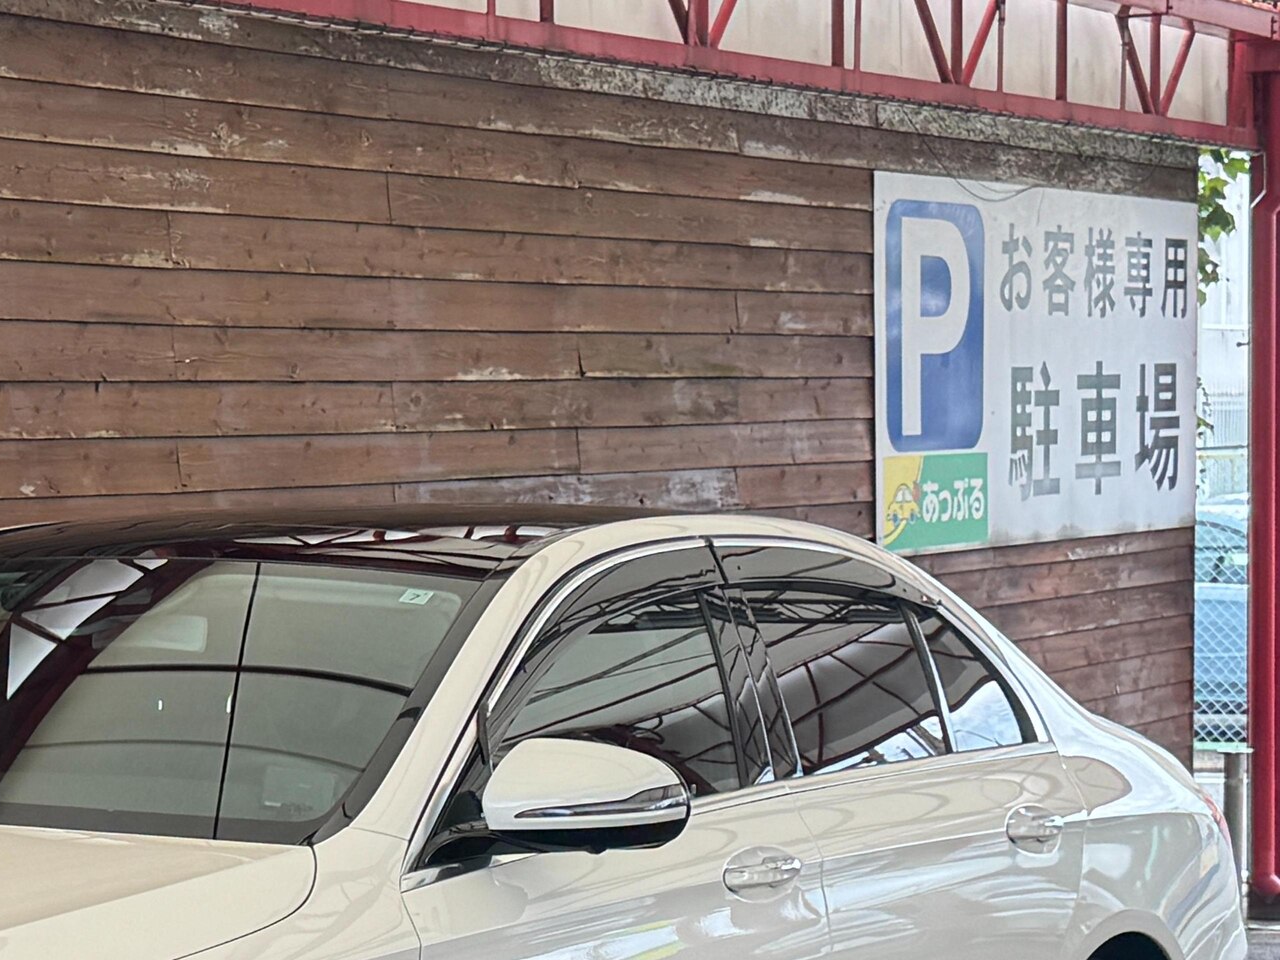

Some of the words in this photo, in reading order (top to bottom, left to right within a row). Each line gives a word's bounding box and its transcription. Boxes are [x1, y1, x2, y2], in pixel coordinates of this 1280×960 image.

[901, 216, 970, 436] P
[999, 223, 1188, 319] お客様専用
[1008, 360, 1180, 501] 駐車場
[922, 477, 985, 523] あっぷる
